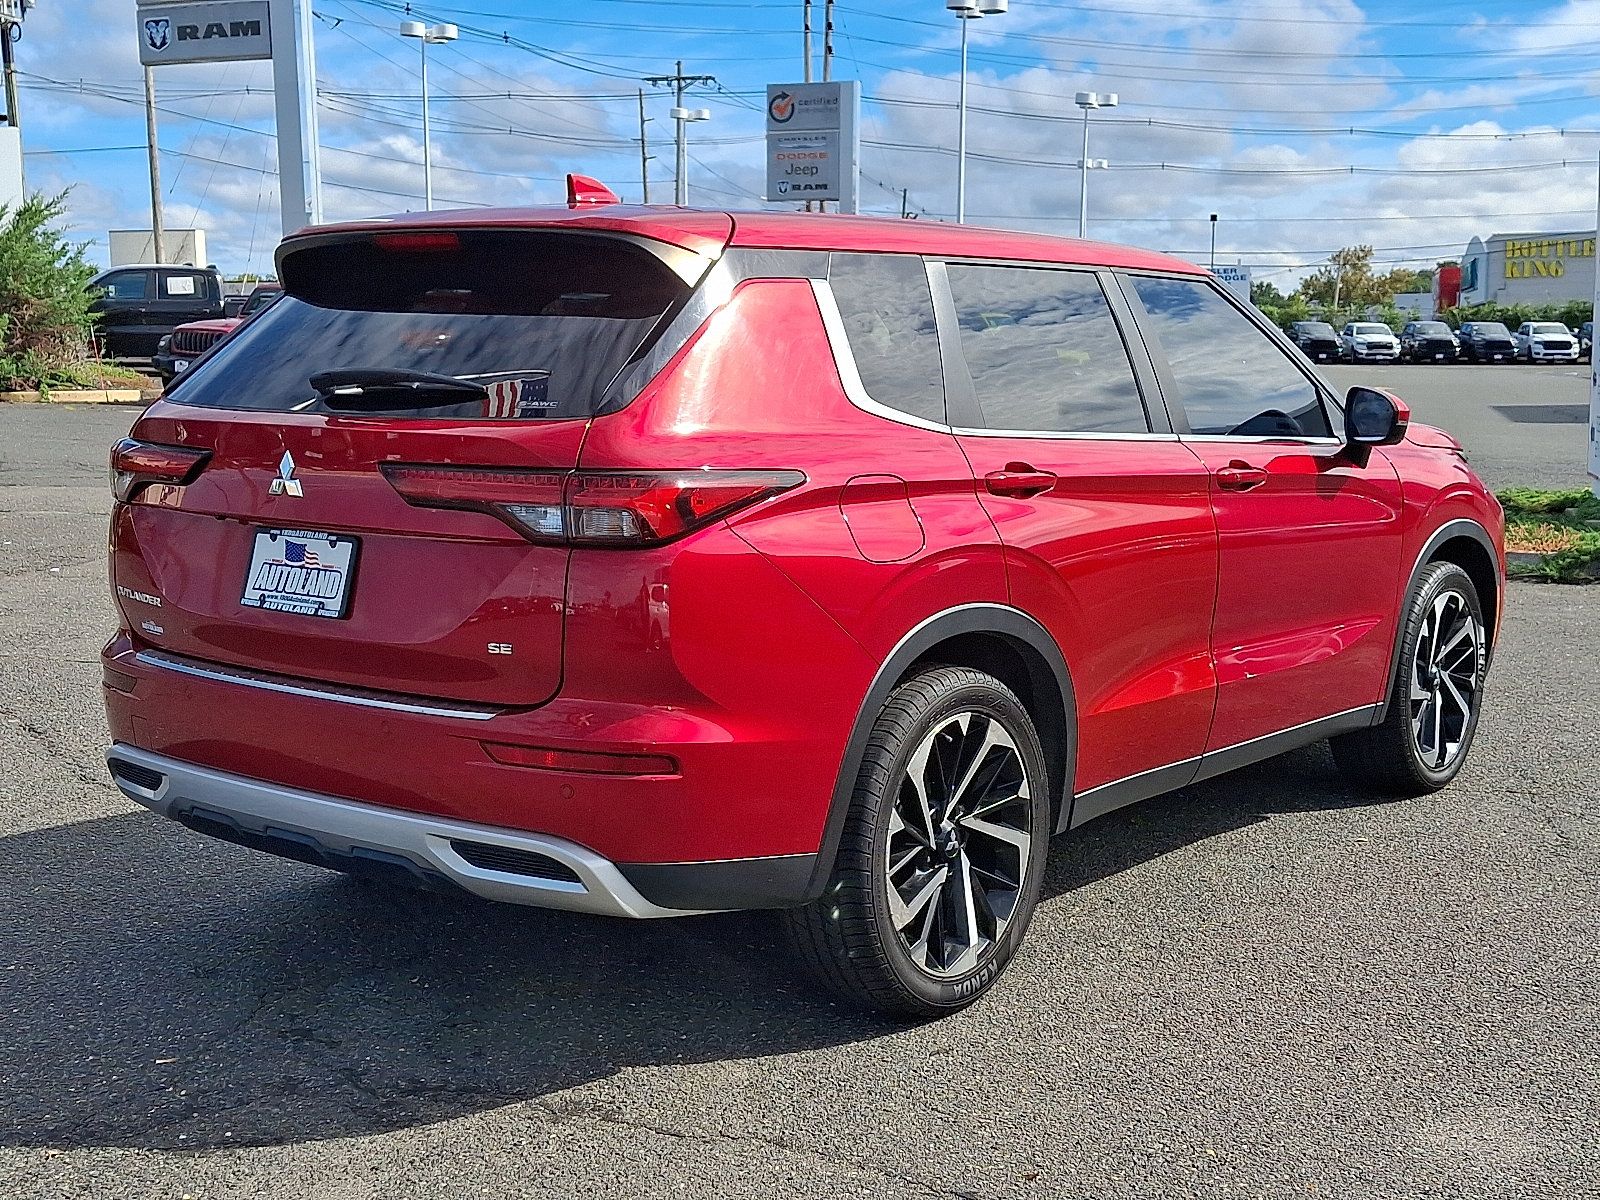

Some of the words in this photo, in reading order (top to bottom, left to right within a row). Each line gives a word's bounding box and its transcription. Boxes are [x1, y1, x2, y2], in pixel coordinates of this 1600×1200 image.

[176, 20, 261, 41] RAM
[798, 96, 838, 106] certified
[776, 152, 829, 161] DODGE
[785, 163, 819, 177] Jeep
[791, 183, 829, 191] RAM
[1505, 239, 1595, 258] BOTTLE
[1504, 260, 1564, 278] KING
[253, 562, 342, 599] AUTOLAND
[262, 601, 316, 615] AUTOLAND
[487, 642, 513, 655] SE
[953, 958, 998, 1000] KENDA
